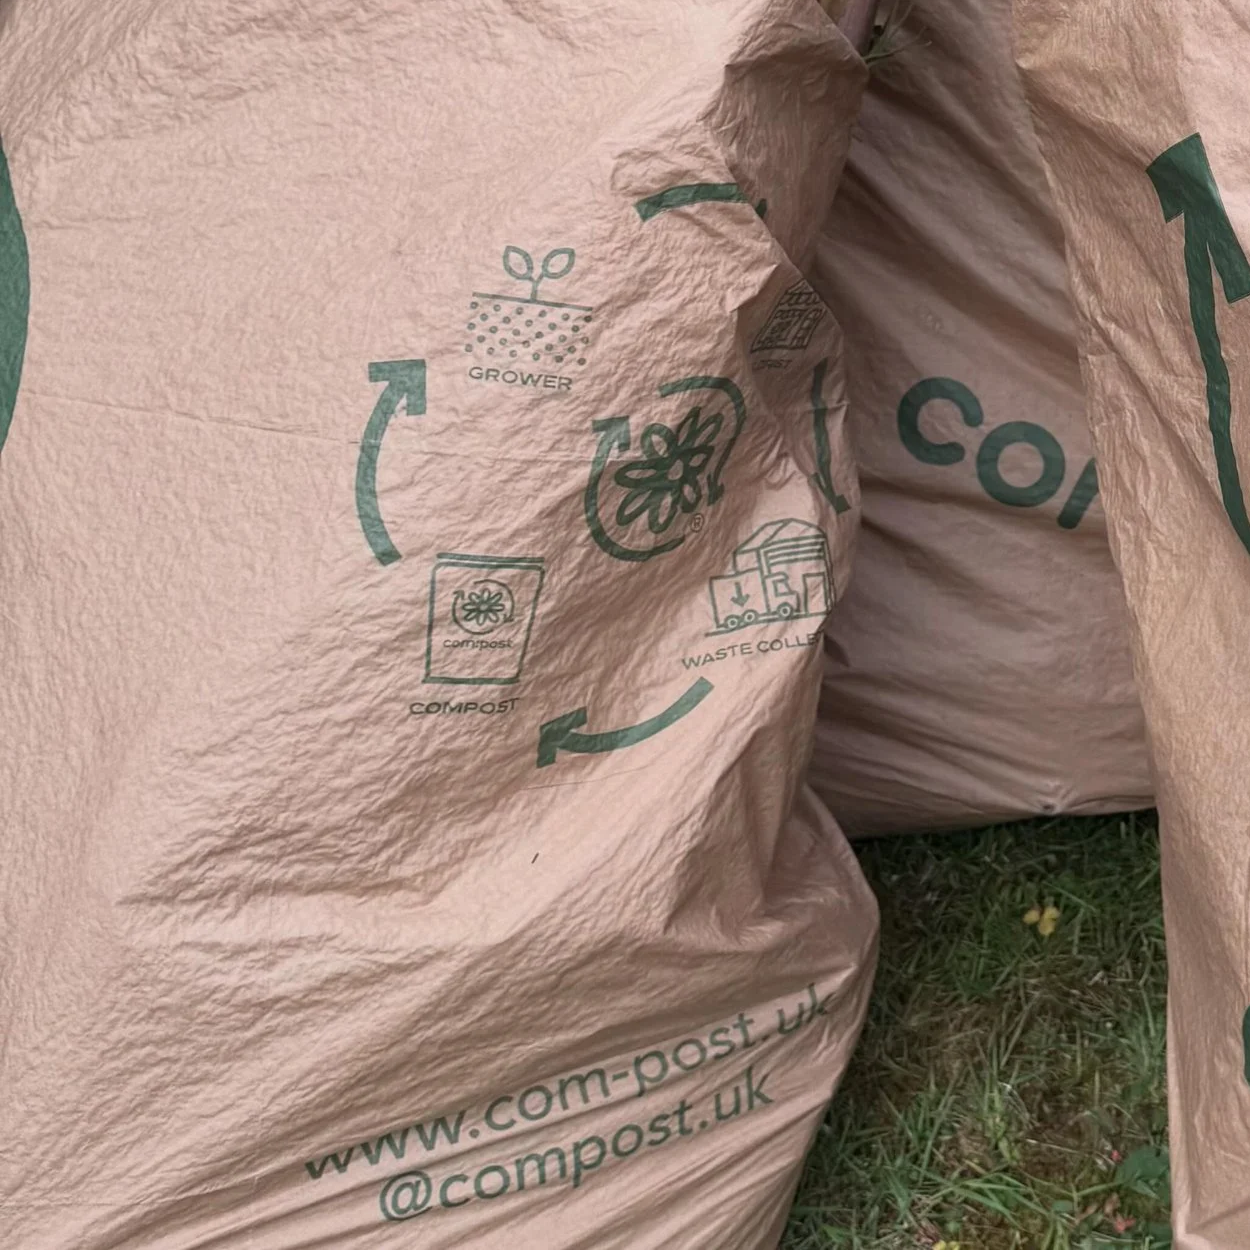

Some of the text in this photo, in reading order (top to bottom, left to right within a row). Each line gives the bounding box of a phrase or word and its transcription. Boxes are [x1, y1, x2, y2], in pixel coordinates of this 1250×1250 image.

[468, 366, 573, 391] GROWER
[681, 642, 753, 670] WASTE
[409, 697, 520, 715] COMPOST
[304, 982, 836, 1181] www.com-post.uk
[378, 1064, 774, 1222] @compost.uk
